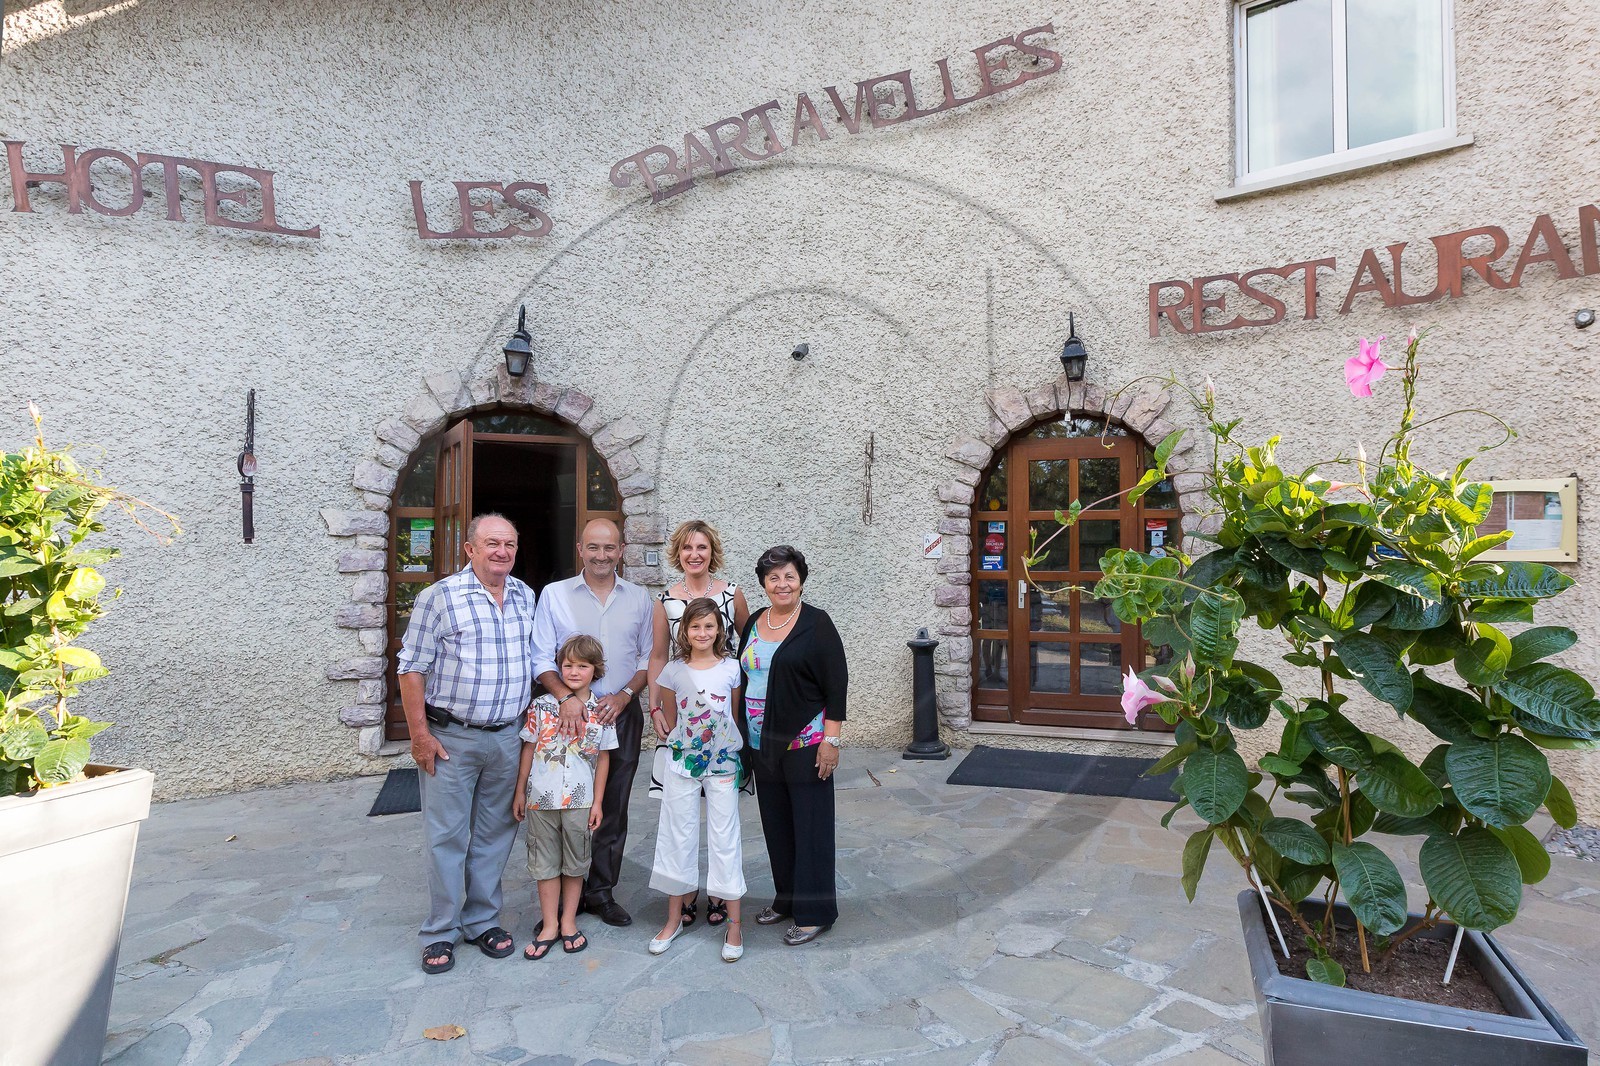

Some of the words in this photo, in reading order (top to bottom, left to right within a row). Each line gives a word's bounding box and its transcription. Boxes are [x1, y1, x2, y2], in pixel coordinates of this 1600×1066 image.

[2, 140, 321, 239] HOTEL
[409, 180, 553, 239] LES
[608, 22, 1063, 205] BARTAVELLES
